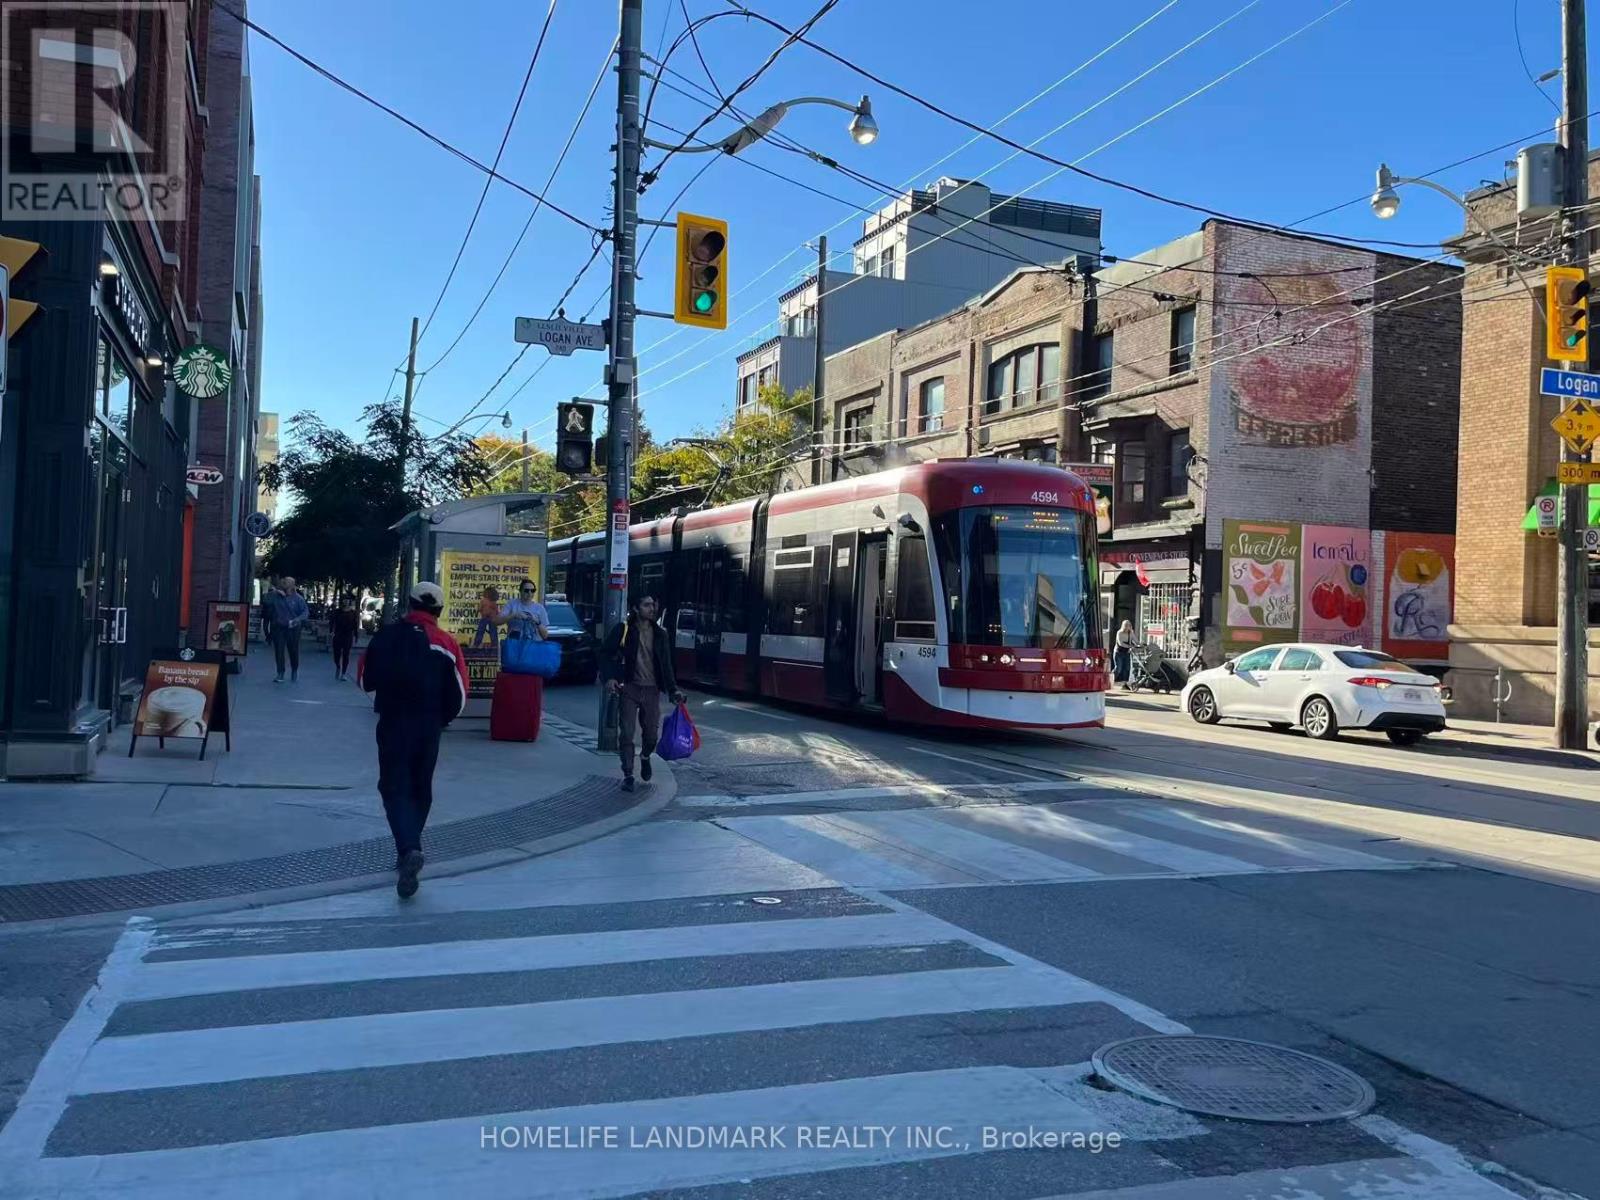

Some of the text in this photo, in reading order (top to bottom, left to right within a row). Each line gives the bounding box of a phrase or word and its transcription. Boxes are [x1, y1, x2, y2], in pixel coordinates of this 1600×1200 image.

[540, 331, 593, 347] LOGAN AVE
[1558, 372, 1598, 395] Logan
[1562, 467, 1584, 478] 300
[1031, 491, 1058, 503] 4594
[450, 563, 529, 574] GIRL ON FIRE
[450, 573, 480, 581] EMPIRE
[479, 574, 500, 582] STATE
[449, 608, 480, 618] KNOW
[918, 647, 936, 658] 4594
[158, 665, 209, 676] Banana bread
